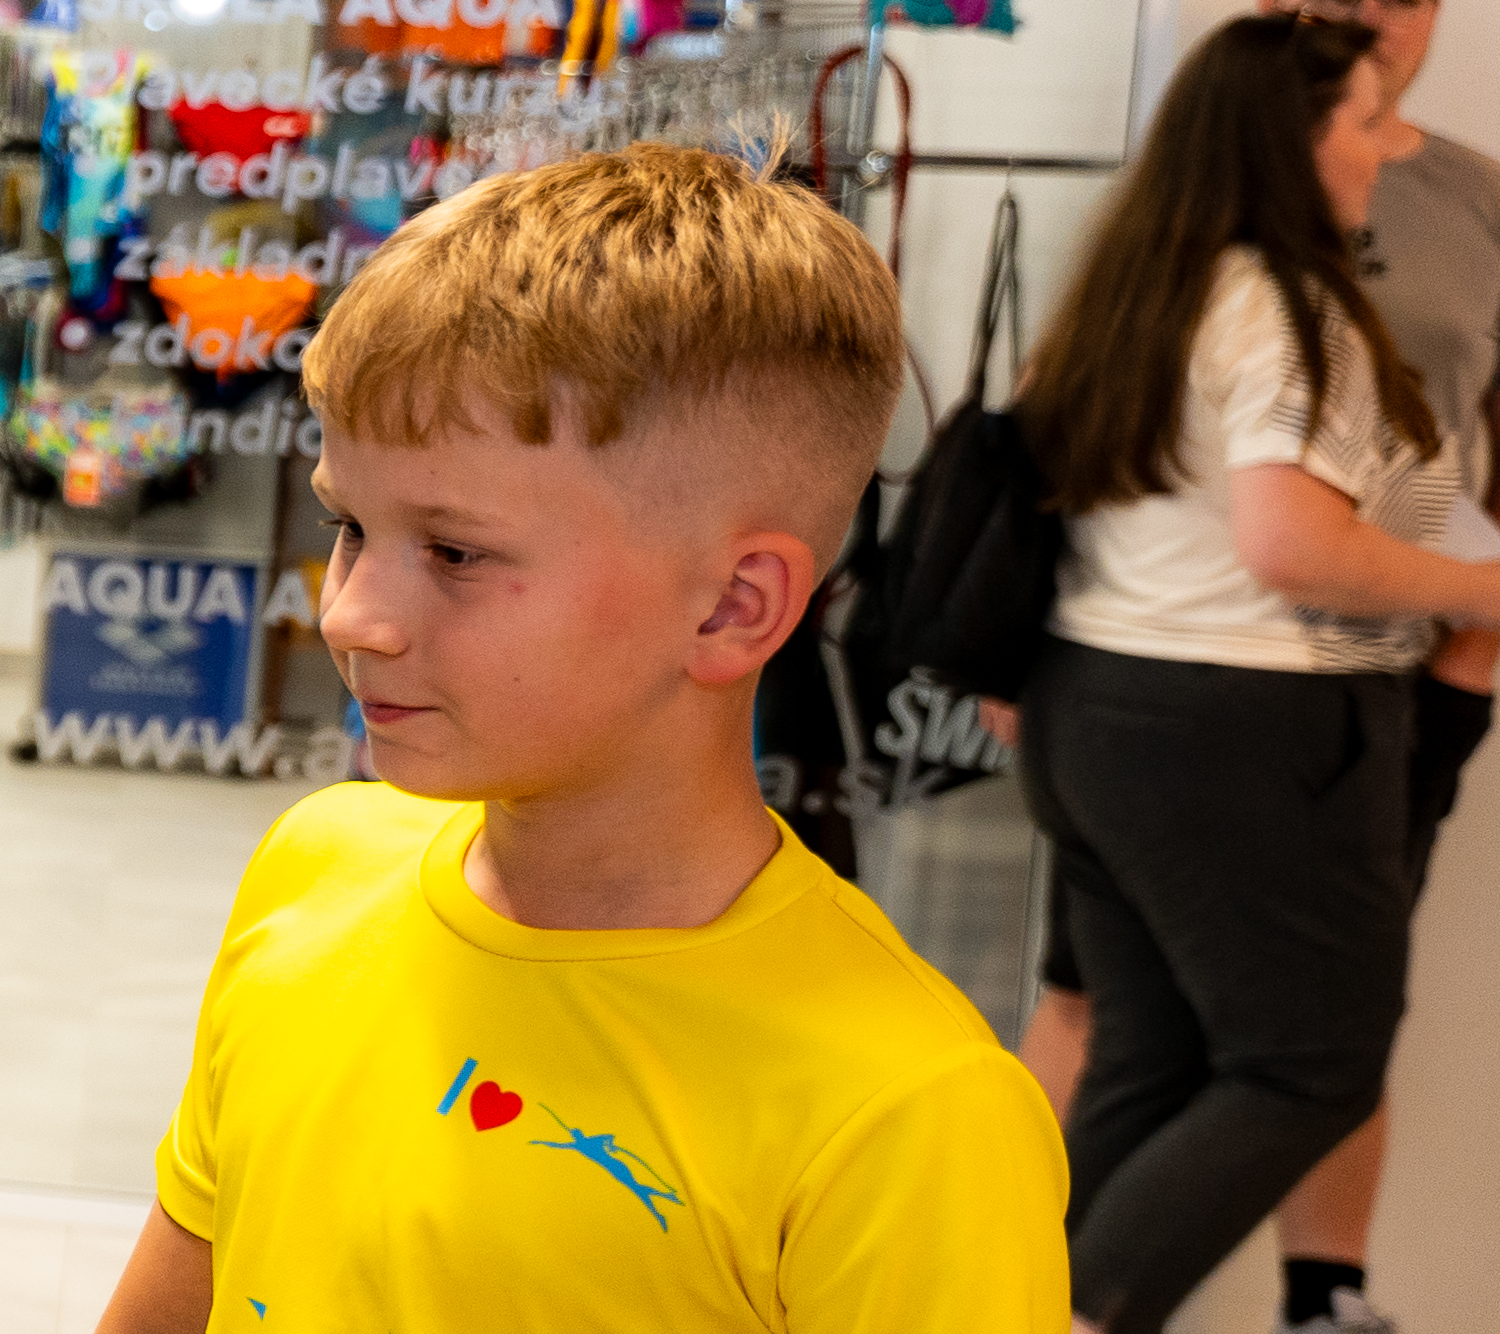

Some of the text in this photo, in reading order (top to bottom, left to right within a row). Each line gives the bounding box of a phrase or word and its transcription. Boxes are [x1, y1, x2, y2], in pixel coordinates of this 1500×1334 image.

[130, 138, 476, 214] predplave
[113, 223, 374, 287] základn
[107, 312, 312, 373] zdoko
[40, 559, 320, 626] AQUA A
[34, 707, 362, 780] www.a
